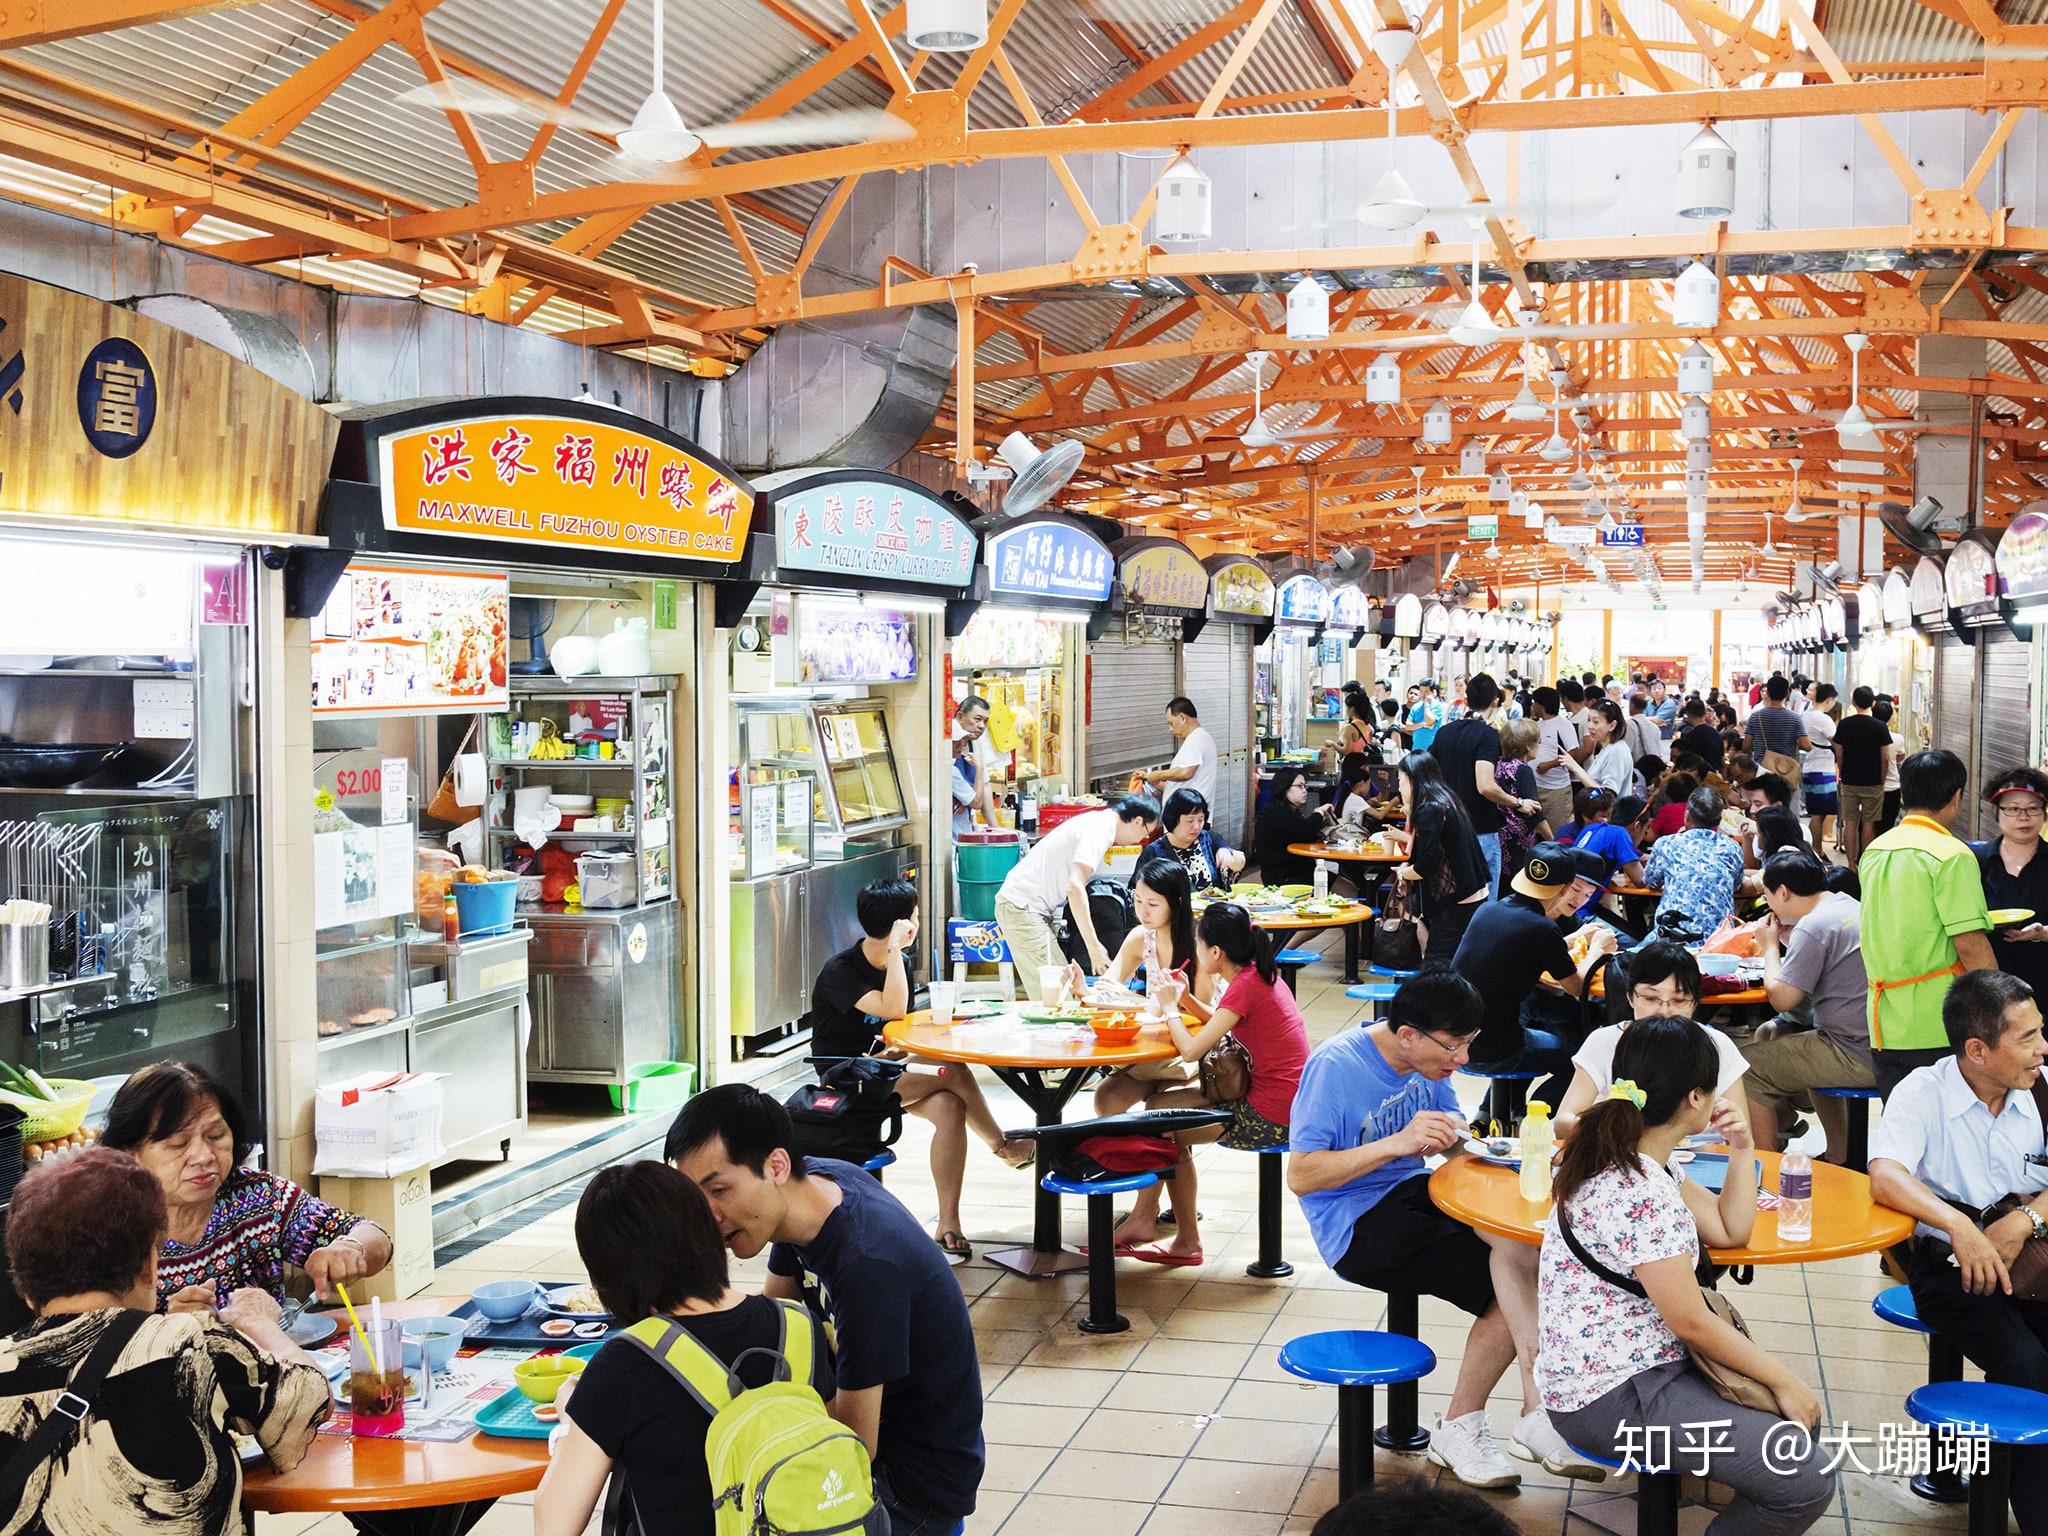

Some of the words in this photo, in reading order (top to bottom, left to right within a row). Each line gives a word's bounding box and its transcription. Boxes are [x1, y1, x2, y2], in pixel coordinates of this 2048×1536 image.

[94, 359, 145, 437] 富
[418, 500, 533, 530] MAXWELL
[539, 513, 620, 540] FUZHOU
[624, 524, 689, 547] OYSTER
[694, 533, 734, 553] CAKE
[1475, 527, 1492, 536] EXIT
[820, 544, 862, 569] TANGLIN
[865, 549, 899, 574] CRISPY
[901, 555, 931, 577] CURRY
[931, 560, 952, 580] PUFF
[214, 574, 237, 608] A
[337, 768, 381, 798] $2.00
